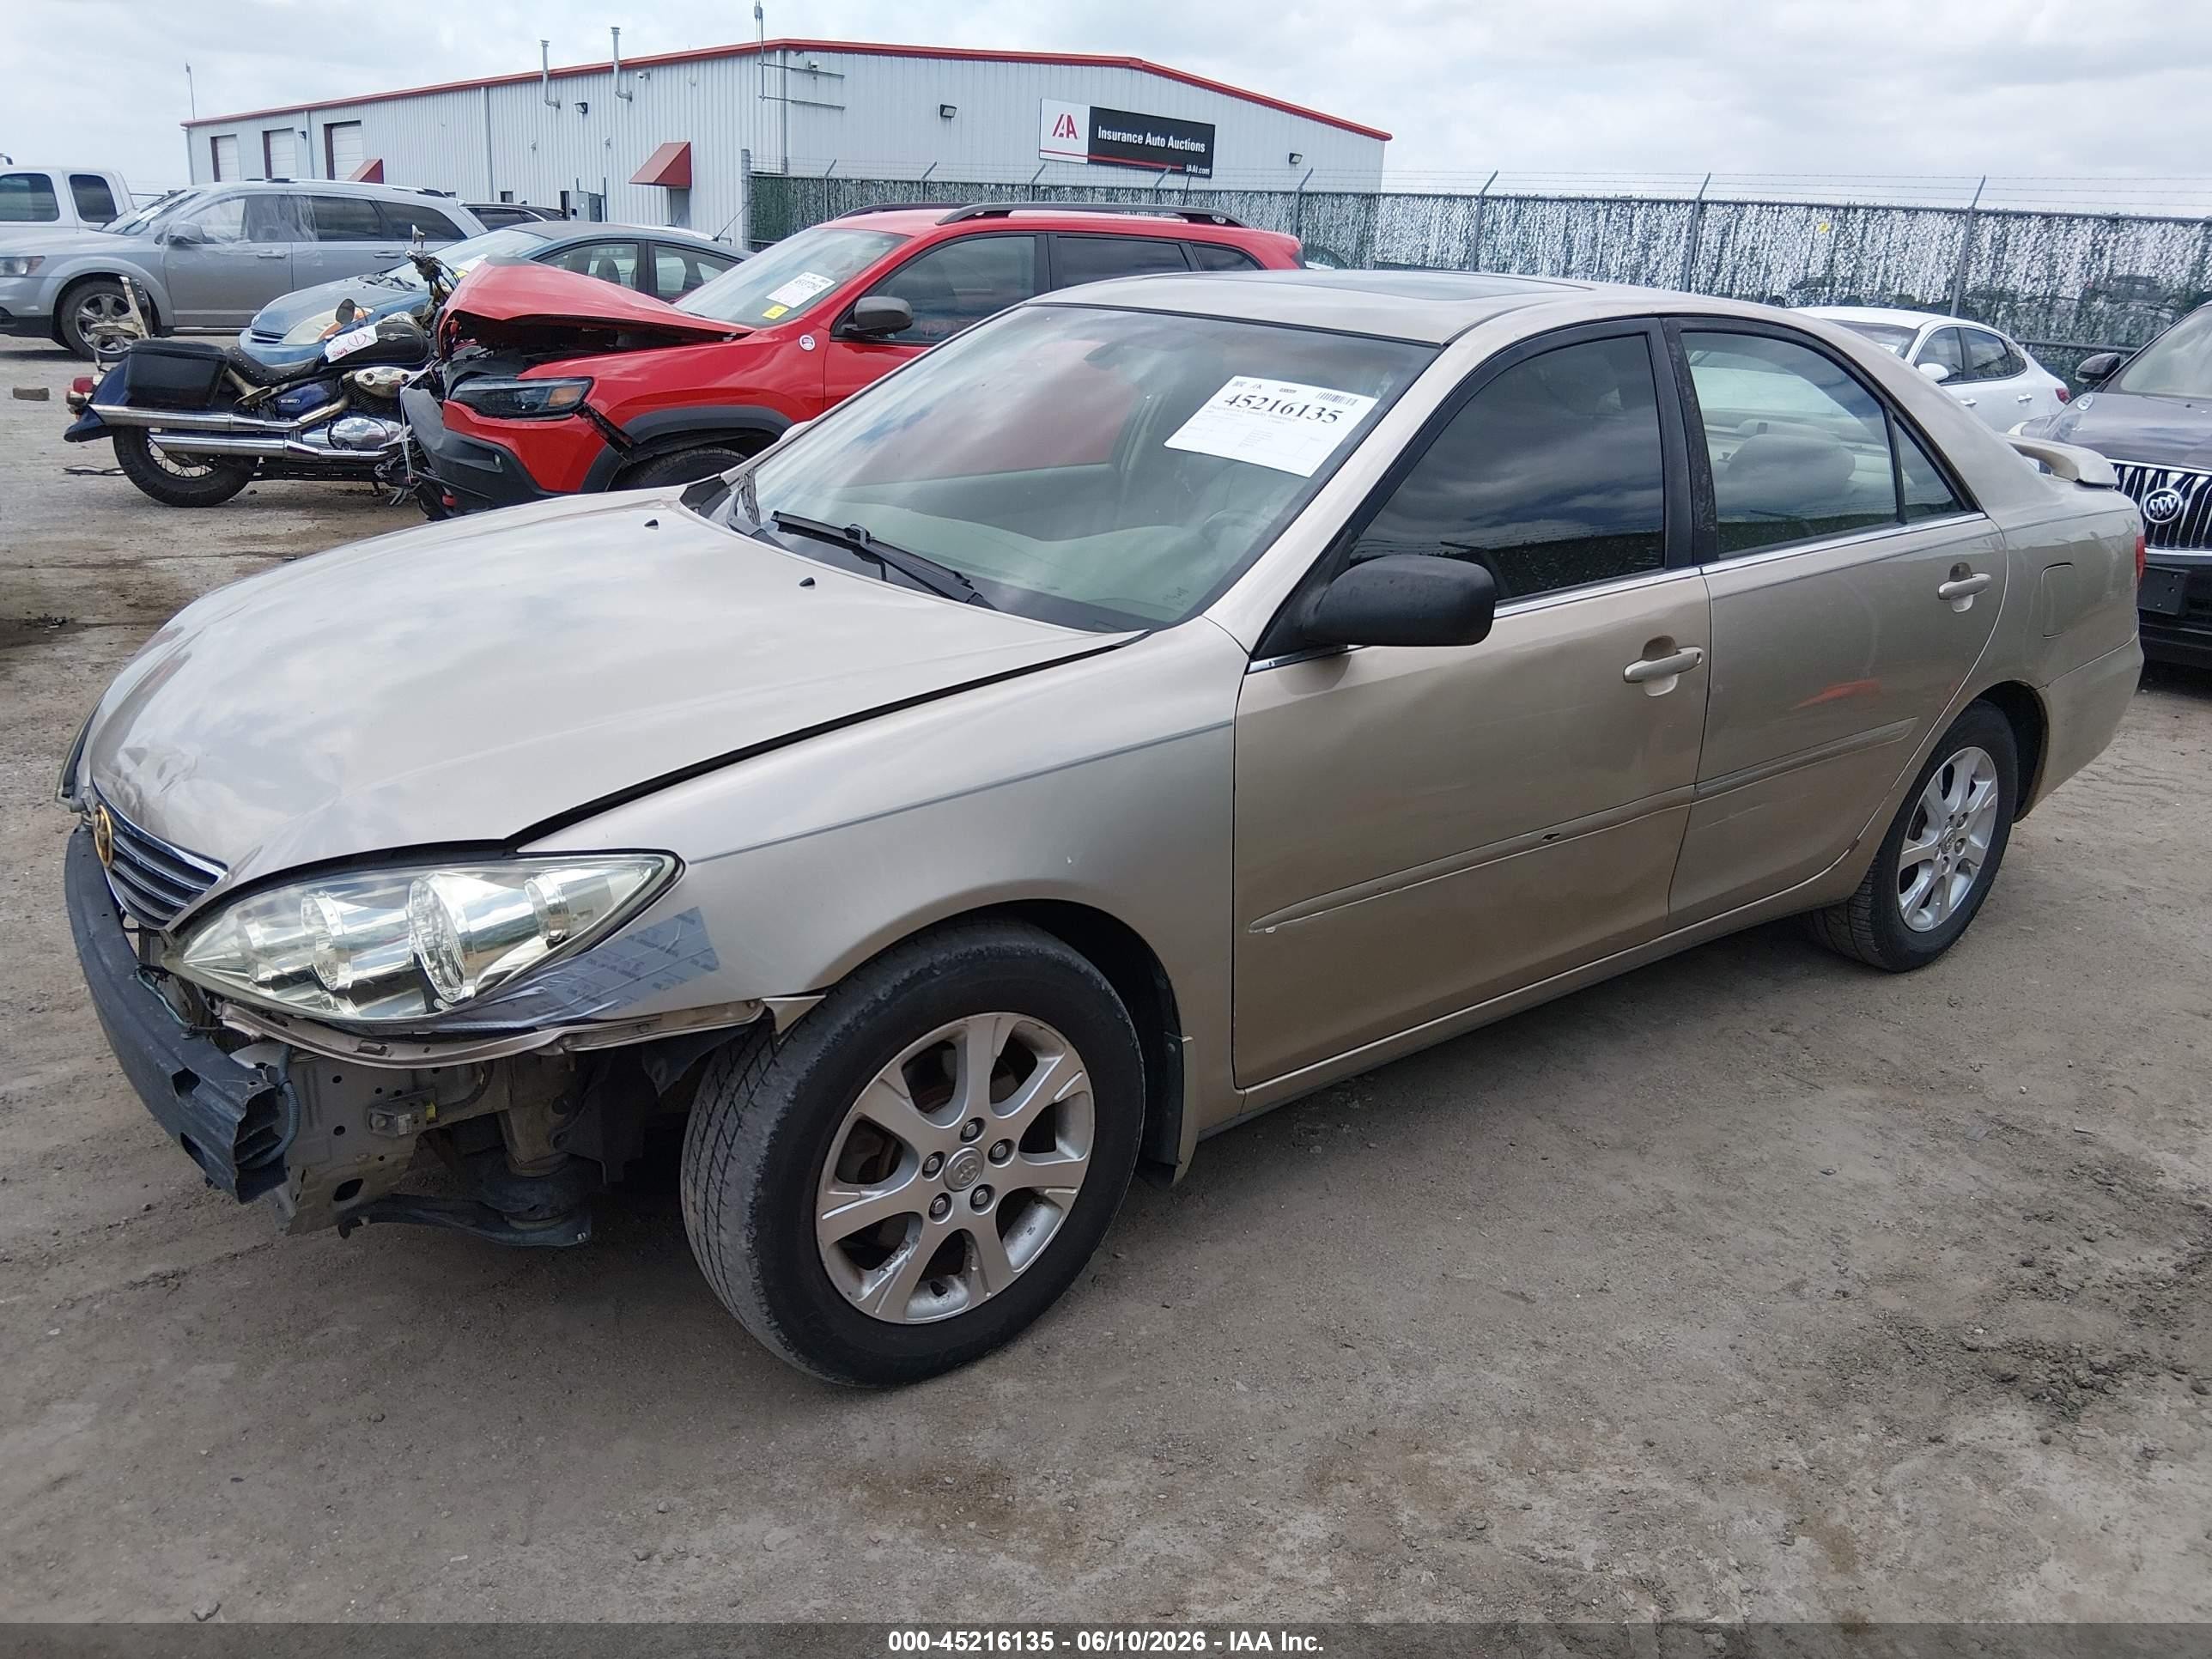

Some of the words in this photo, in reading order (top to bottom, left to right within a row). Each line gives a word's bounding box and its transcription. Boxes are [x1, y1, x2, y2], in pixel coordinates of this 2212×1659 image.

[1098, 125, 1143, 144] Insurance
[1145, 132, 1166, 148] Auto
[1168, 136, 1206, 153] Auctions
[1224, 393, 1344, 424] 45216135
